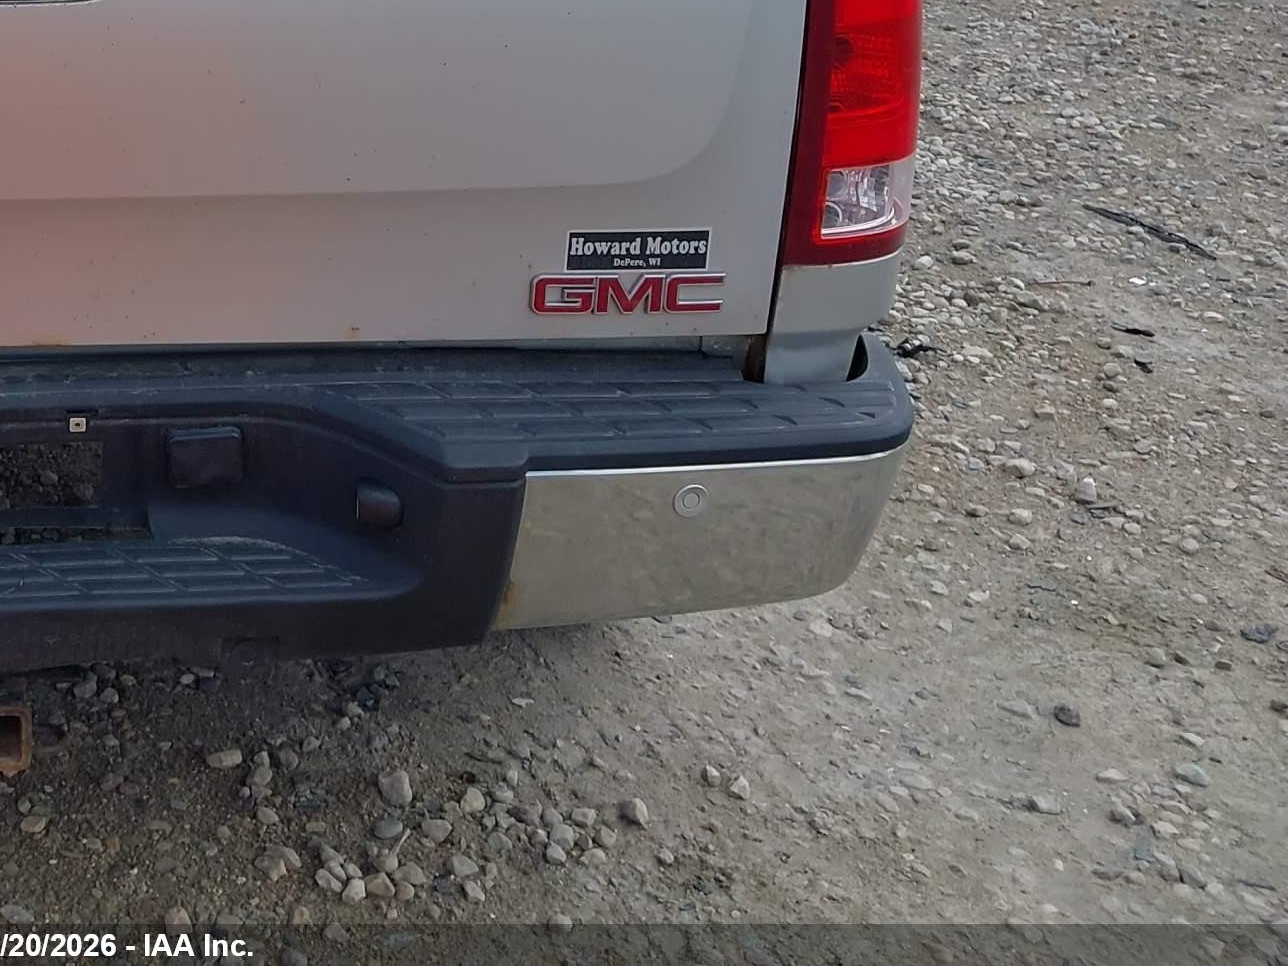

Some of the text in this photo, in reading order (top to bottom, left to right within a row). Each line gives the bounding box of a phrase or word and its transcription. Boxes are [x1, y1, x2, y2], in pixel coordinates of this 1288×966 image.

[569, 236, 707, 256] Howard Motors
[613, 258, 661, 268] DePere, WI
[531, 273, 727, 315] GMC
